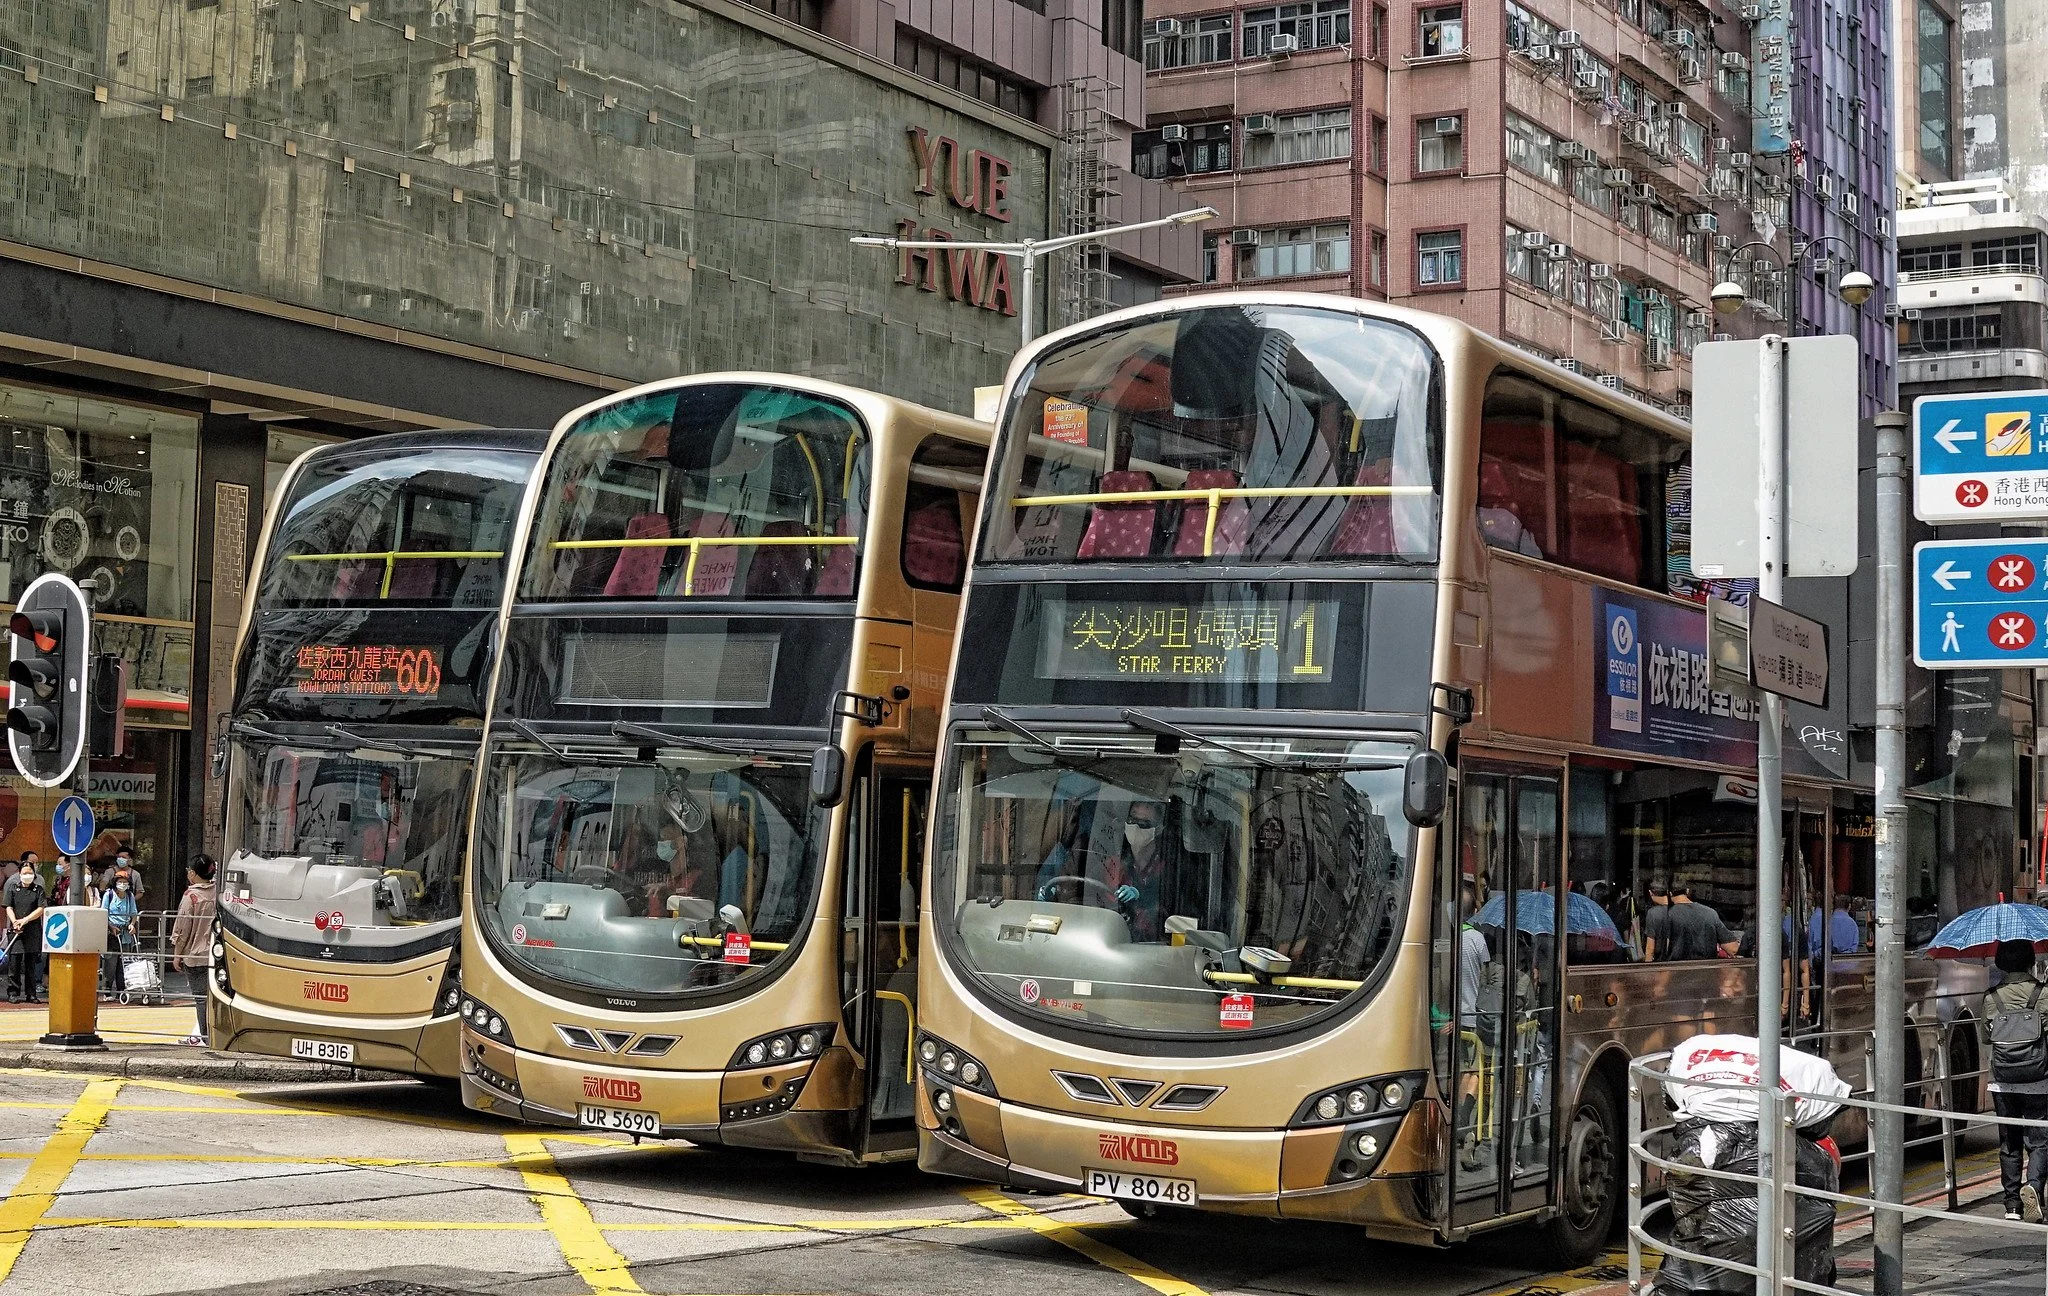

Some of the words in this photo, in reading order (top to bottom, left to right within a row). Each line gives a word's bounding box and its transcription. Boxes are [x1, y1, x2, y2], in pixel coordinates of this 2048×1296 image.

[906, 125, 1012, 223] YUE
[895, 217, 1017, 317] HWA
[1048, 422, 1077, 431] Anniversary
[51, 468, 95, 492] Melodies
[96, 483, 103, 492] in
[103, 475, 141, 498] Motion
[1994, 495, 2022, 508] Hong
[1073, 606, 1280, 650] 尖沙咀碼頭
[1293, 603, 1323, 674] 1
[296, 646, 401, 669] 佐敦西九龍站
[1118, 656, 1160, 673] STAR
[1173, 656, 1227, 674] FERRY
[311, 669, 346, 681] JORDAN
[350, 669, 380, 681] (WEST
[297, 681, 341, 693] KOWLOON
[343, 682, 391, 694] STATION)
[316, 982, 349, 1003] KMB
[606, 997, 637, 1007] VOLVO
[297, 1040, 313, 1055] UH
[318, 1043, 349, 1060] 8316
[599, 1077, 642, 1103] KMB
[586, 1107, 607, 1126] UR
[612, 1110, 655, 1132] 5690
[1121, 1135, 1179, 1165] KMB
[1093, 1172, 1121, 1195] PV
[1131, 1177, 1190, 1203] 8048
